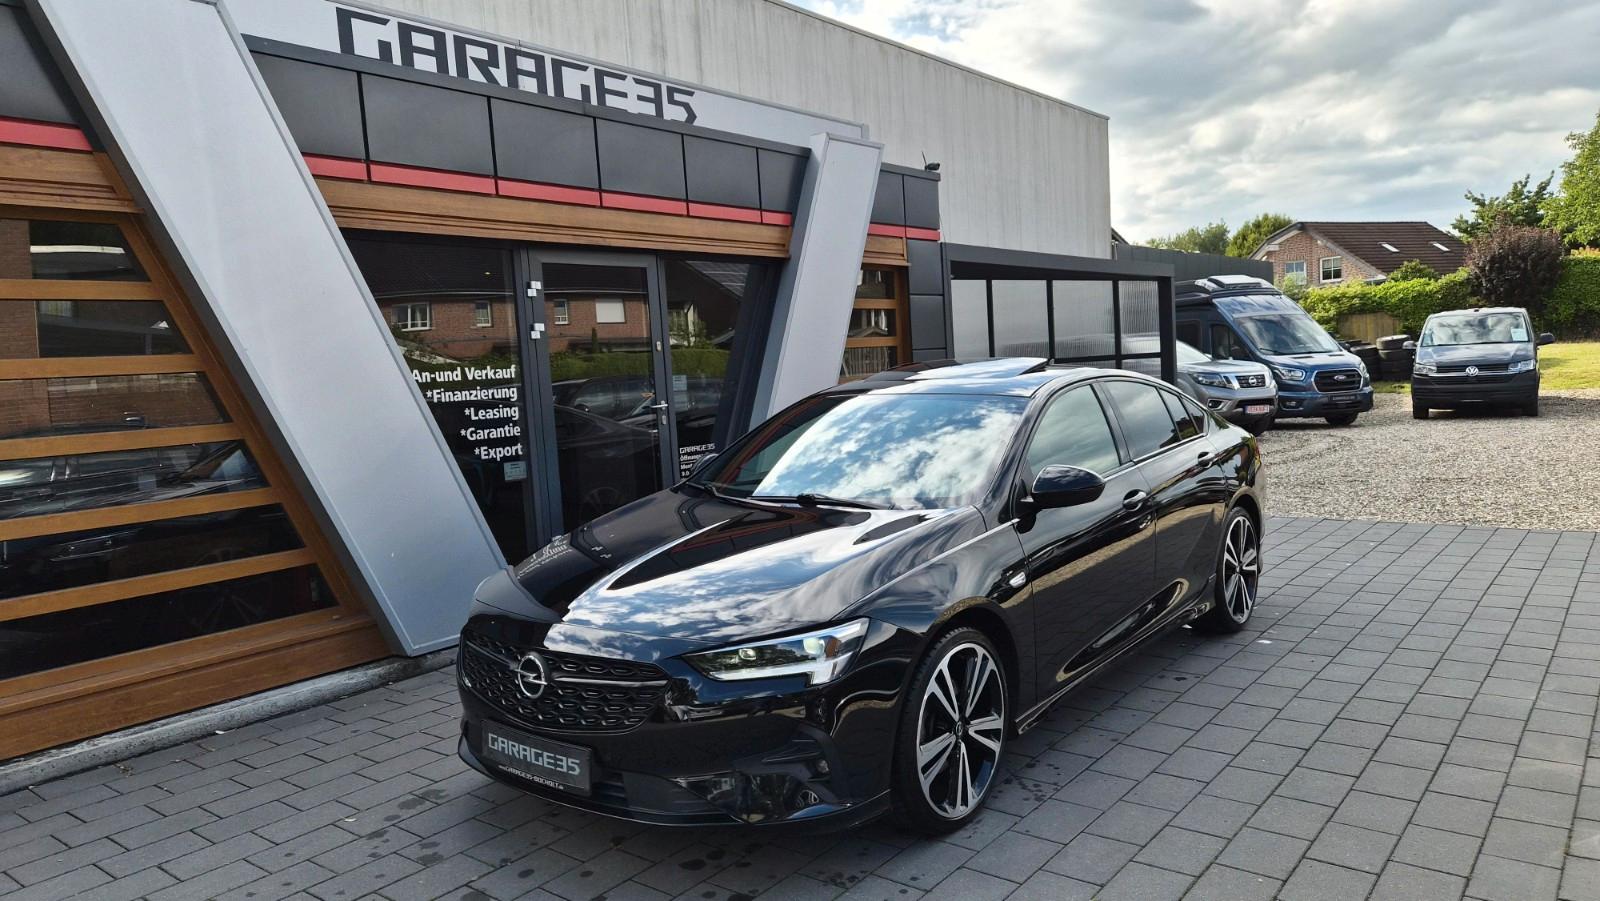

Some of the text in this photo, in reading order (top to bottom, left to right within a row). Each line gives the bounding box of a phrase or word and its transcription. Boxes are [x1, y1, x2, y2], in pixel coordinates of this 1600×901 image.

[336, 7, 697, 125] GARAGE35
[465, 364, 516, 380] Verkauf
[488, 733, 581, 776] GARAGE35
